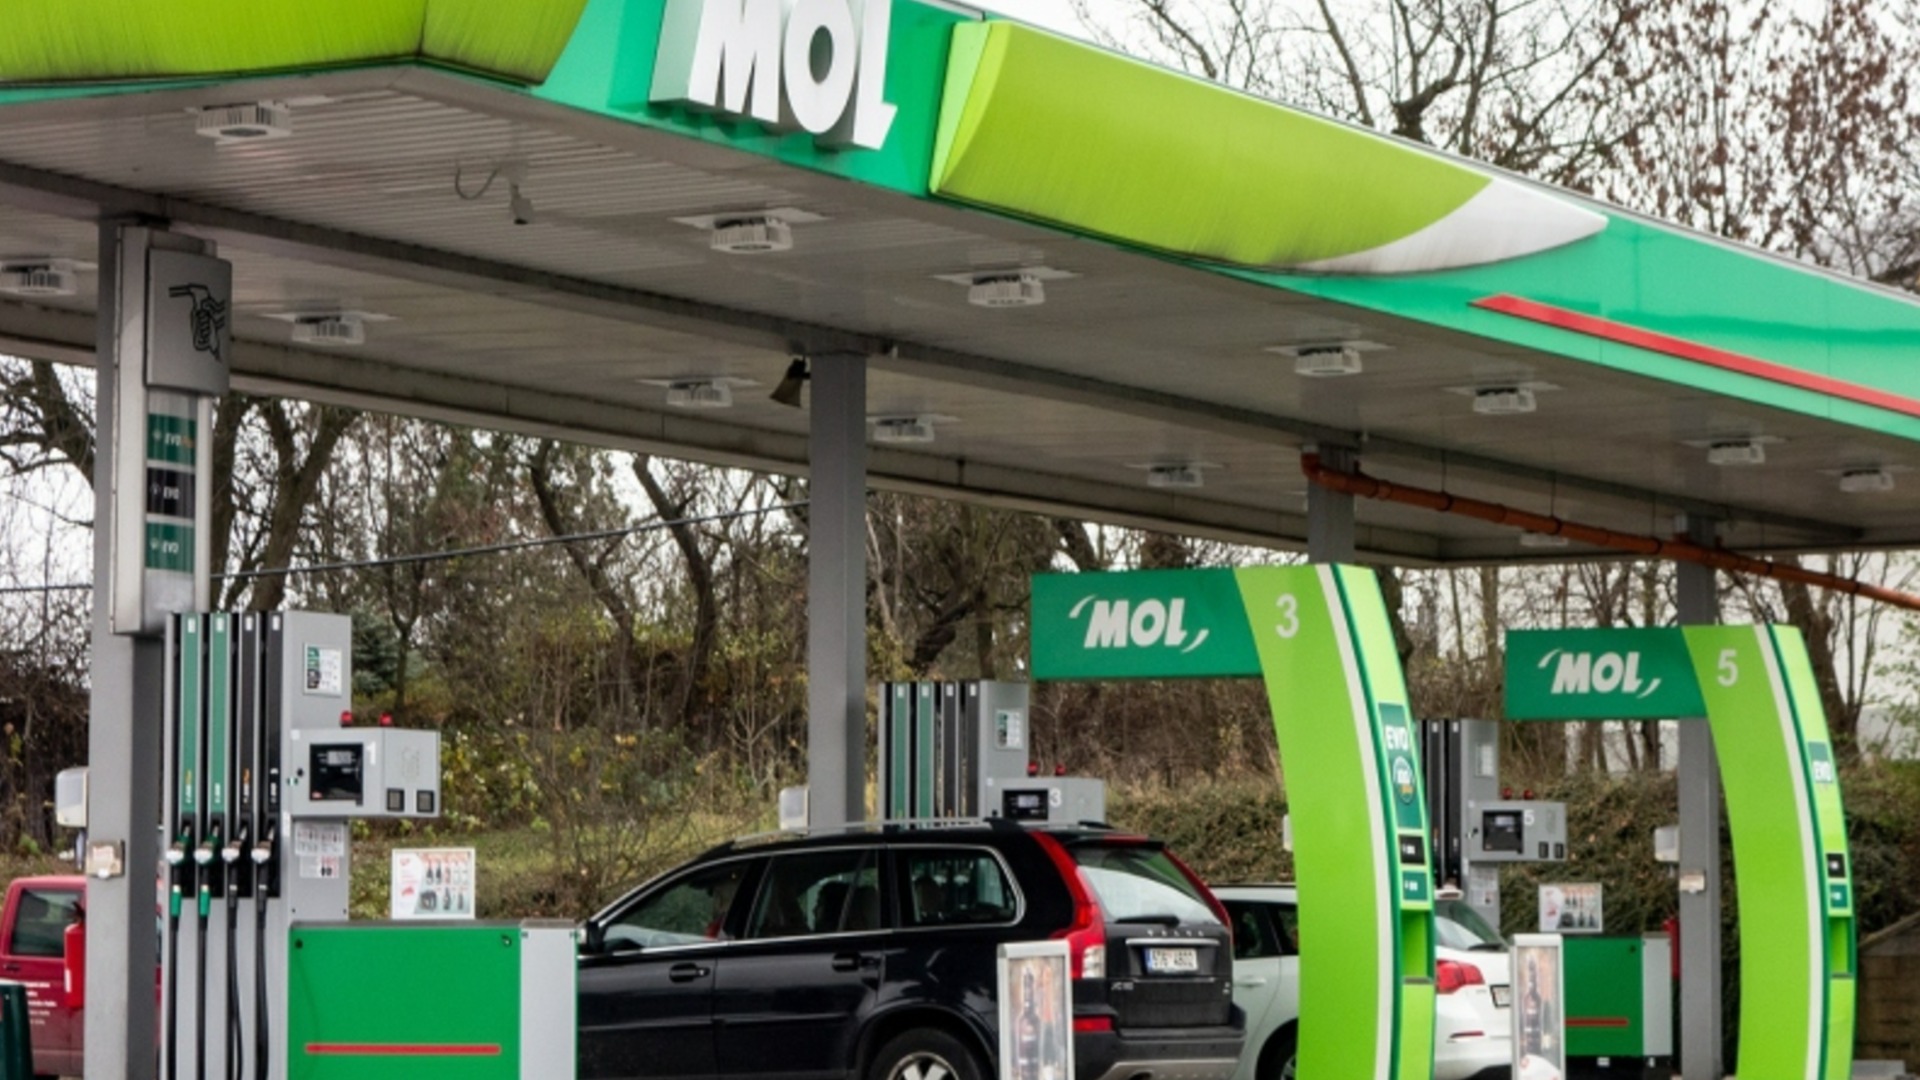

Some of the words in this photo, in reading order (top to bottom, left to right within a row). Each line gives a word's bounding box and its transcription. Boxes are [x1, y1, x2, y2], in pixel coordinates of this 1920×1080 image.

[687, 0, 898, 150] MOL
[1083, 598, 1187, 648] MOL
[1275, 594, 1300, 639] 3
[1551, 652, 1643, 694] MOL
[1717, 649, 1739, 687] 5
[367, 742, 377, 765] 1
[1385, 725, 1409, 750] EVO
[1050, 788, 1061, 807] 3
[1524, 809, 1535, 826] 5
